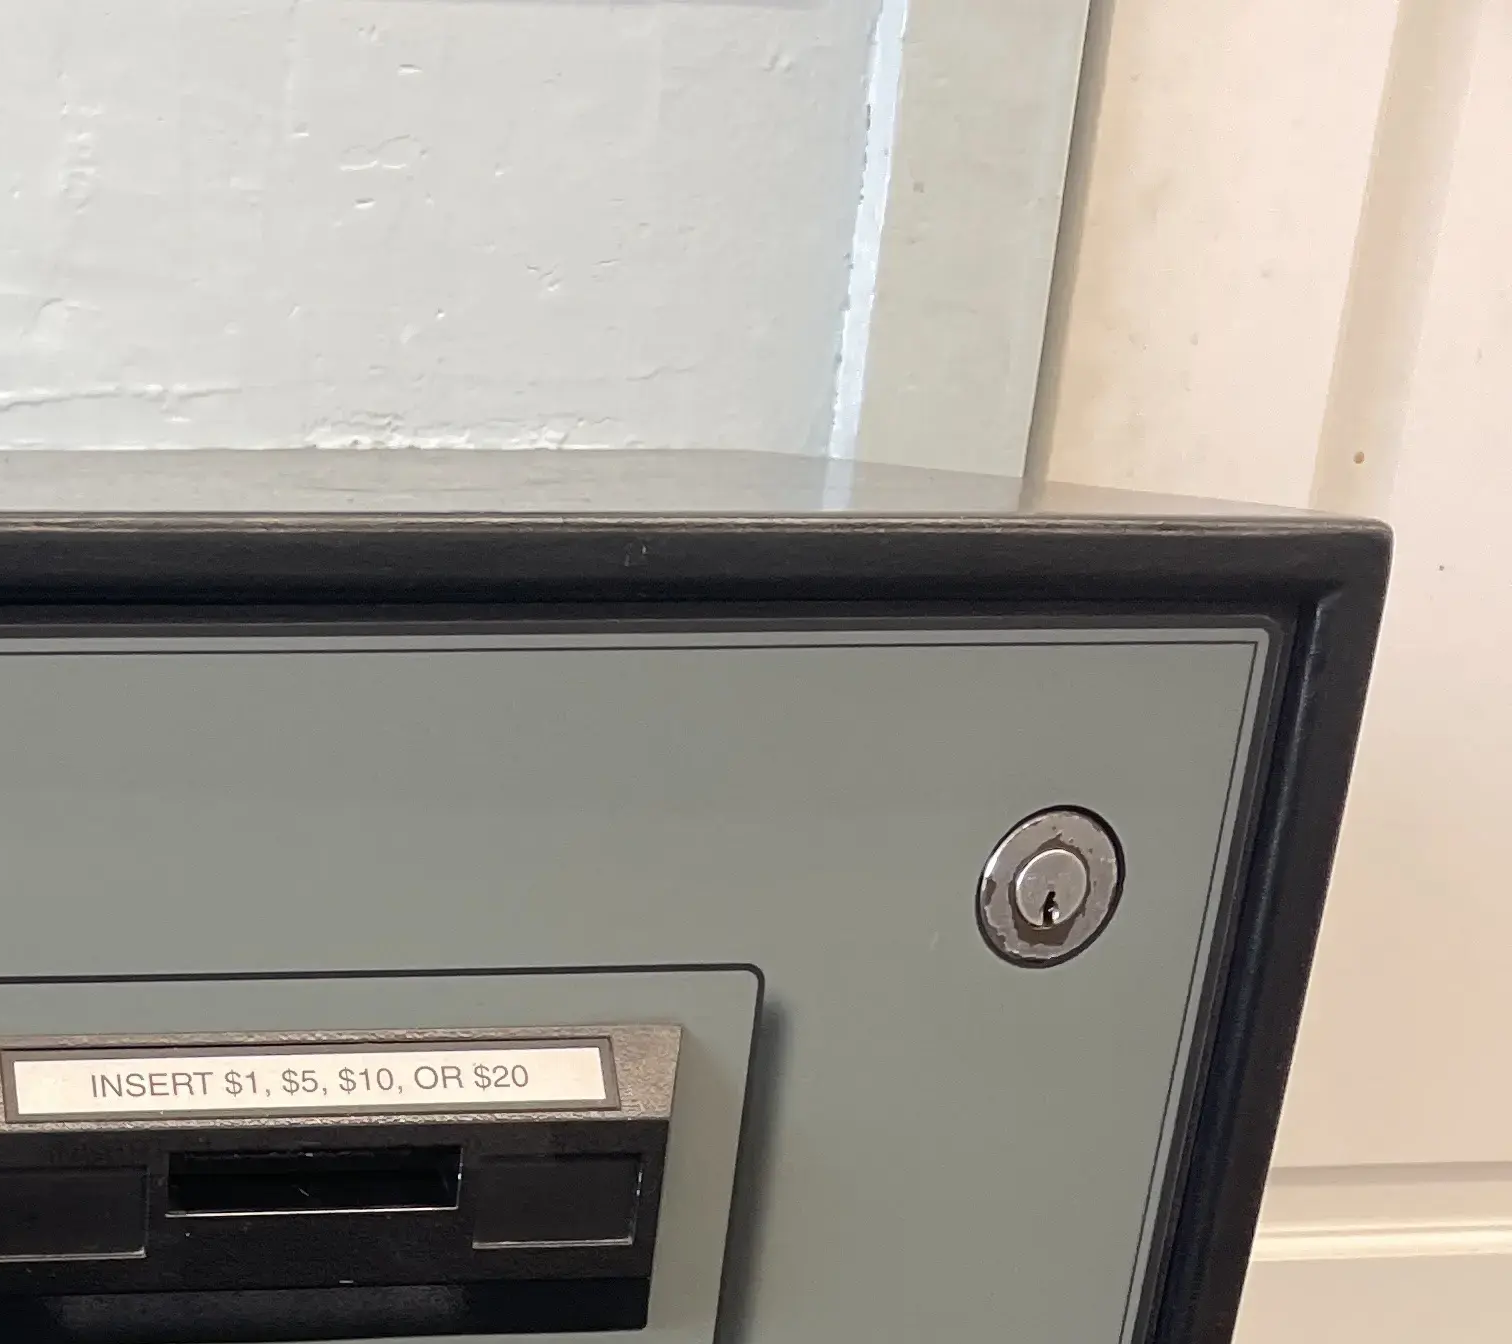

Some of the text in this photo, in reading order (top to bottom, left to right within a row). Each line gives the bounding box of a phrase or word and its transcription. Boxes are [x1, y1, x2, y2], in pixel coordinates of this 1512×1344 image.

[91, 1064, 529, 1098] INSERT $1, $5, $10, OR $20
